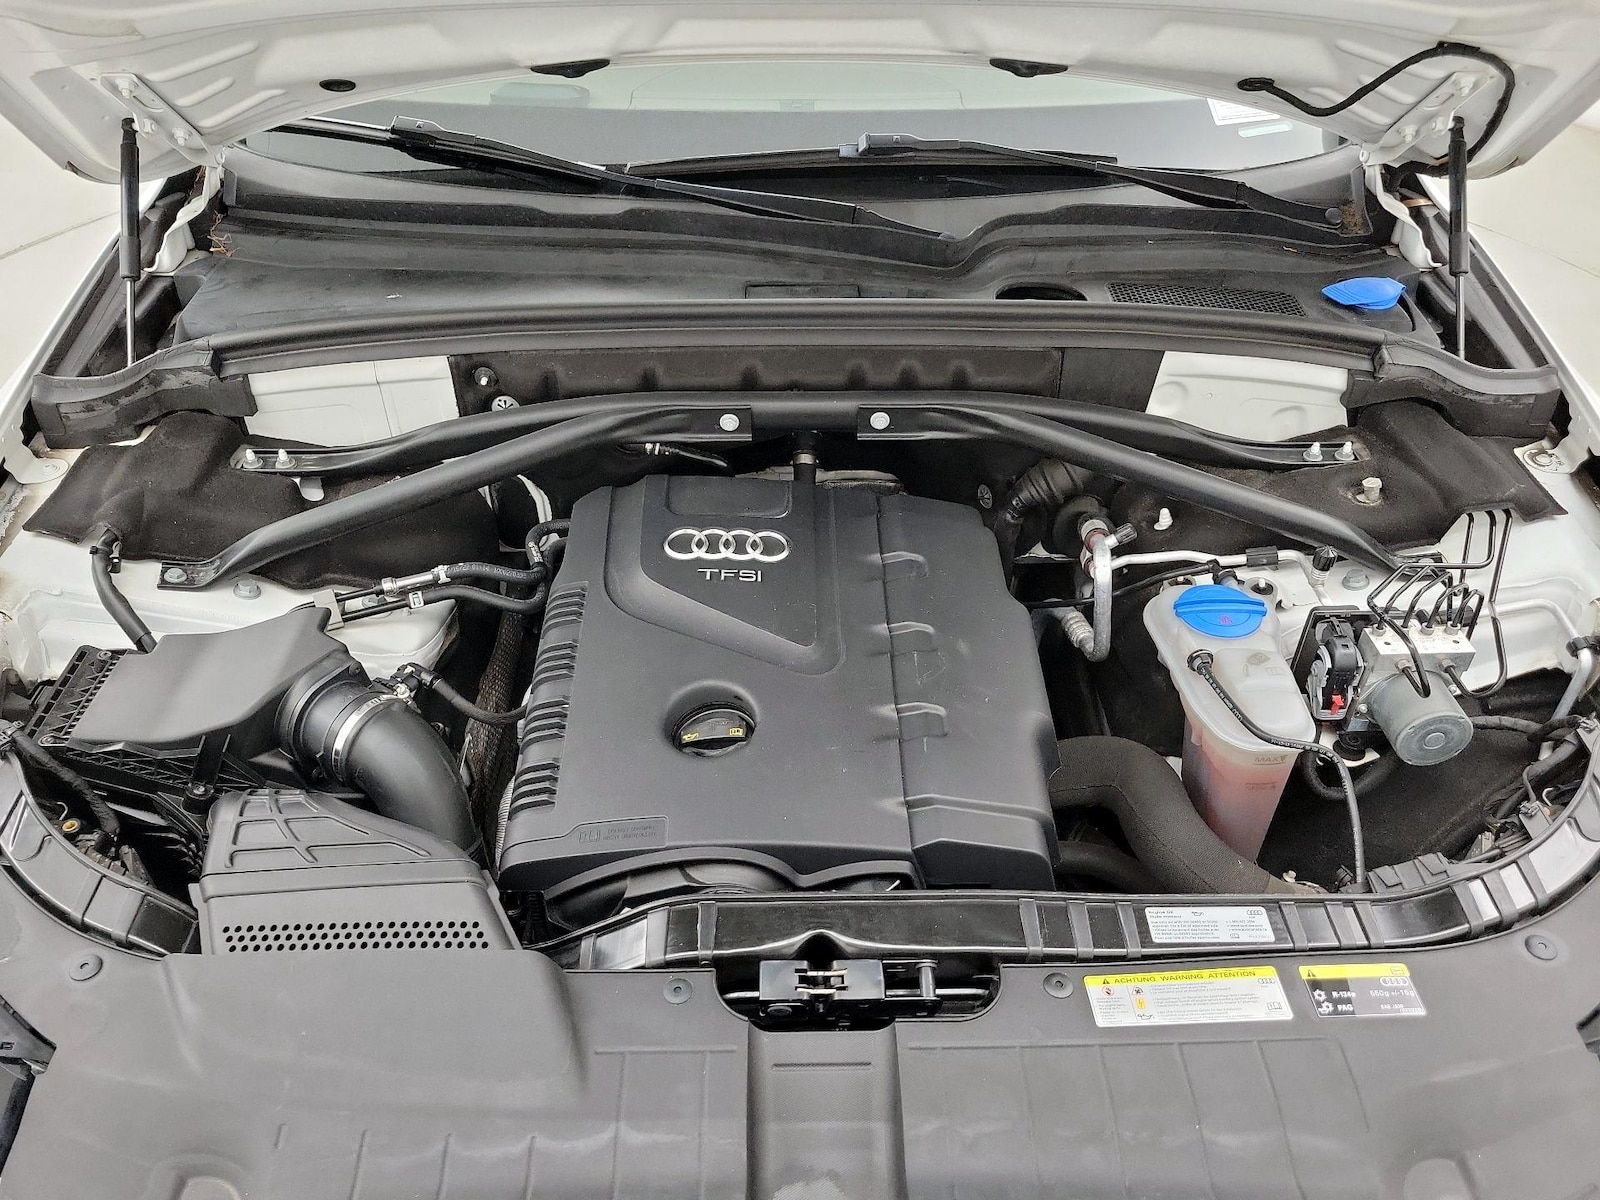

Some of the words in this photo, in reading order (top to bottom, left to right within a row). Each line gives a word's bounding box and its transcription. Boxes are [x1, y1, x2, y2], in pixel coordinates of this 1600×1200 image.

[697, 568, 762, 582] TFSI
[1114, 976, 1156, 984] ACHTUNG
[1160, 973, 1204, 981] WARNING
[1208, 970, 1256, 979] ATTENTION
[1336, 1003, 1354, 1011] PAG
